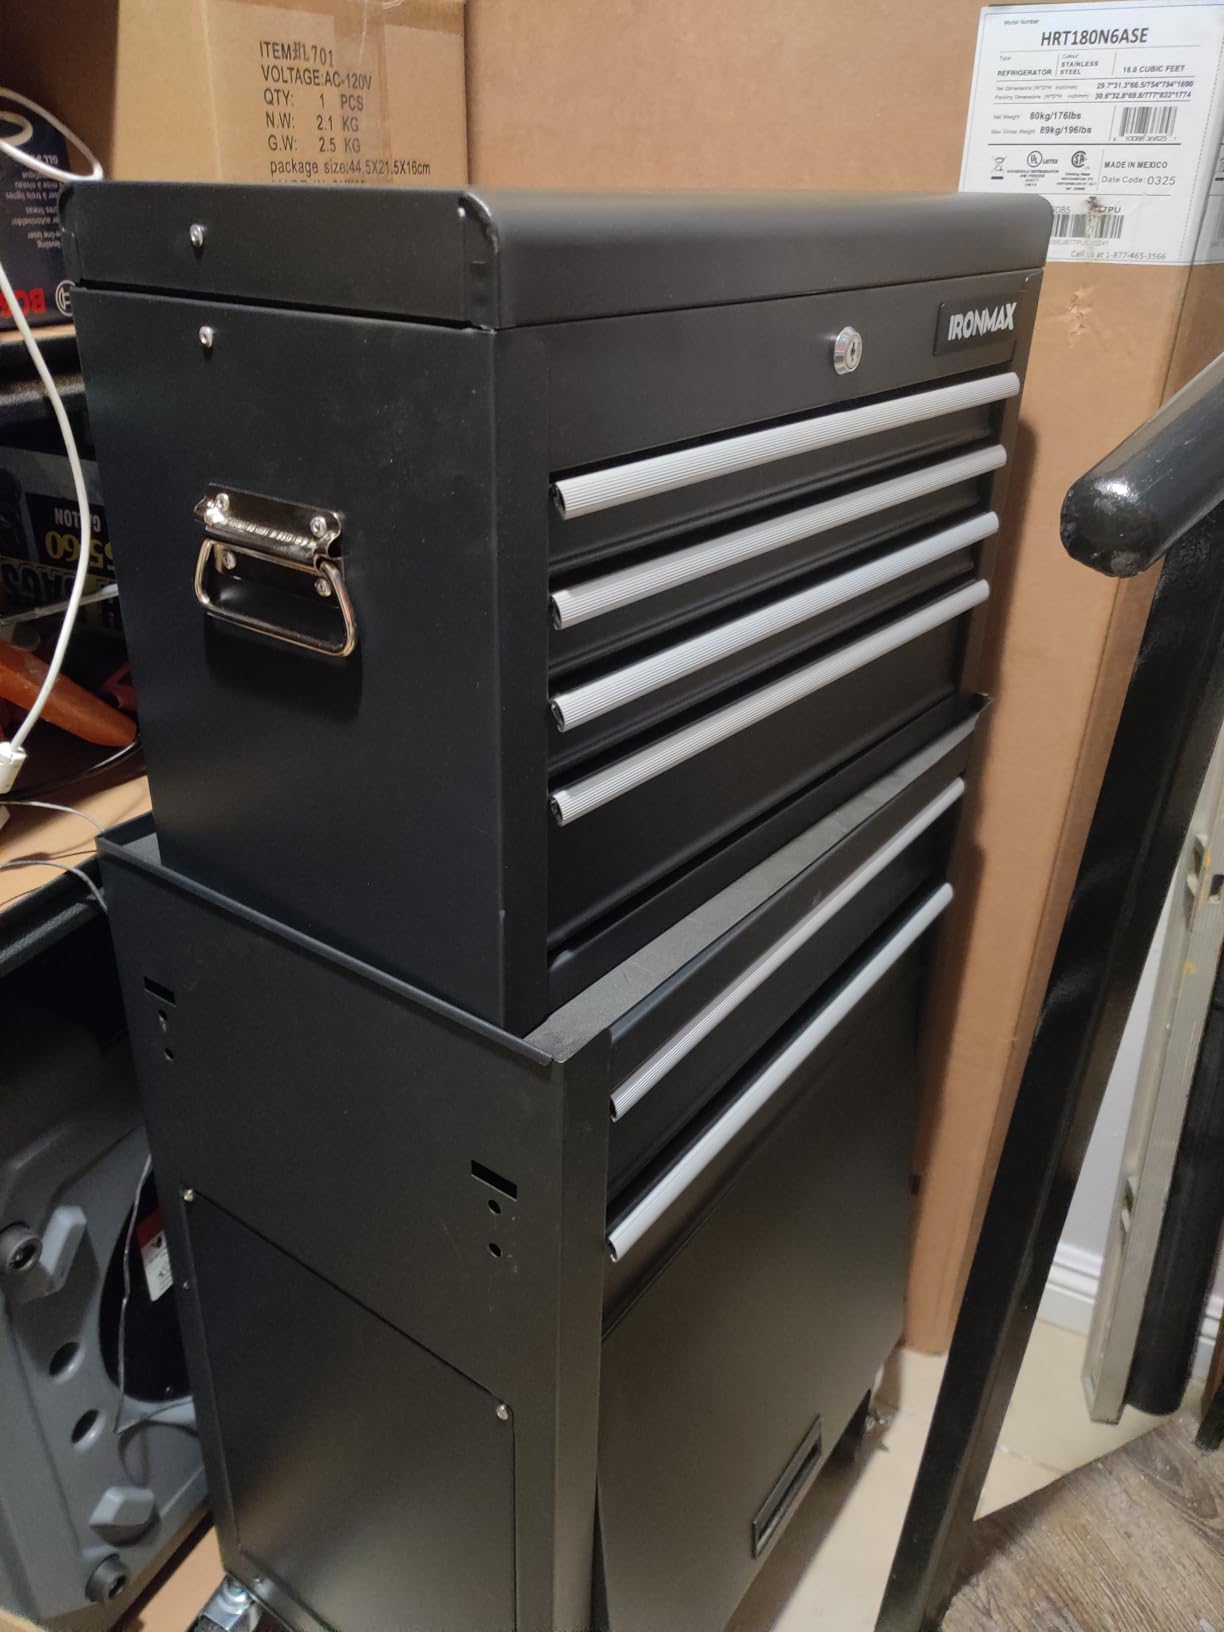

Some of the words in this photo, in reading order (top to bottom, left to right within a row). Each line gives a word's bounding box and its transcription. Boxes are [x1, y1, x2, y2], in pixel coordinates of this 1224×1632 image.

[1040, 27, 1149, 46] HRT180N6ASE
[1165, 64, 1185, 72] FEET
[260, 65, 373, 90] VOLTAGE:AC-120V
[263, 88, 295, 107] QTY:
[319, 94, 325, 108] 1
[340, 94, 364, 112] PCS
[265, 112, 295, 129] N.W:
[316, 115, 333, 131] 2.1
[342, 117, 359, 133] KG
[1029, 111, 1082, 121] 80kg/176lbs
[1039, 126, 1092, 136] 89kg/196lbs
[267, 135, 298, 151] G.W:
[318, 137, 336, 153] 2.5
[344, 138, 361, 153] KG
[270, 159, 318, 177] package
[1101, 175, 1120, 183] Date
[1122, 175, 1146, 183] Code:
[1147, 176, 1176, 185] 0325
[1105, 251, 1167, 260] 1-877-465-3566
[948, 302, 1017, 341] IRONMAX
